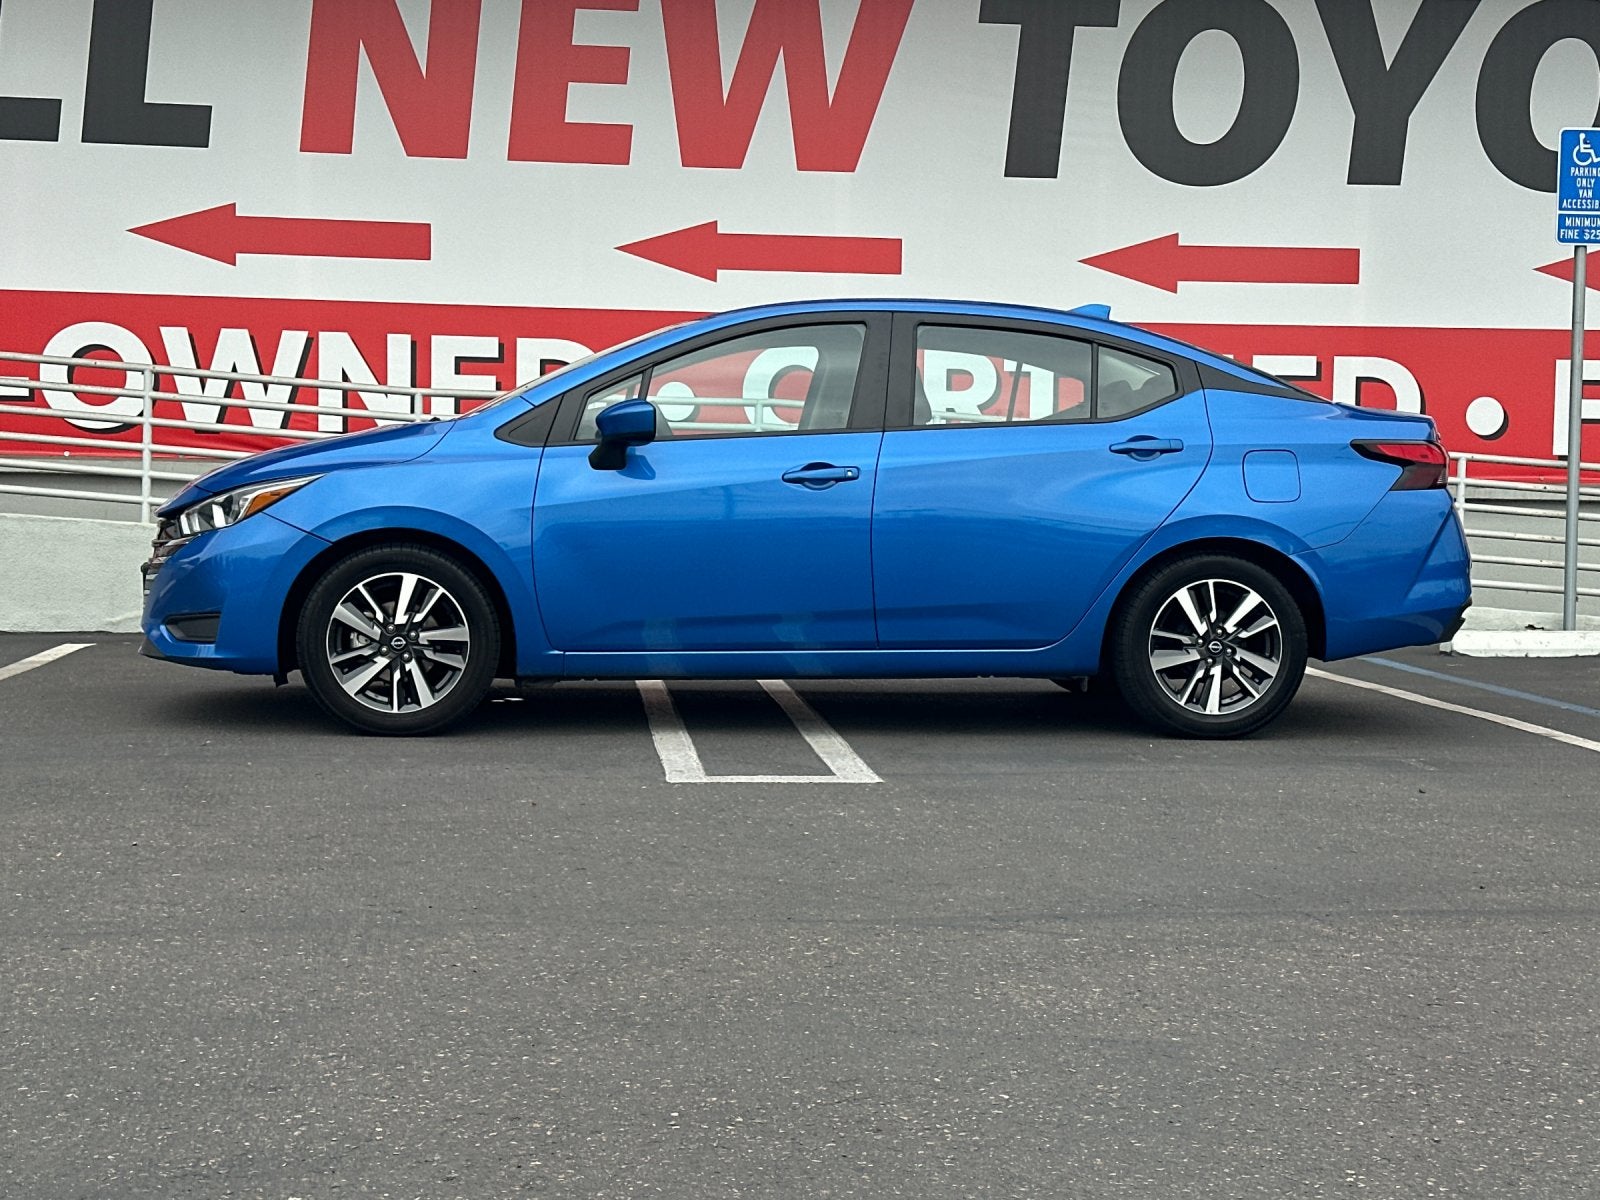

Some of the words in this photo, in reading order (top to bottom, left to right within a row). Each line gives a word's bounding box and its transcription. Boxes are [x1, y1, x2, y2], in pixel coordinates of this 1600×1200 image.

[299, 0, 915, 173] NEW
[978, 0, 1600, 193] TOYO
[1576, 177, 1596, 188] ONLY
[1578, 188, 1593, 199] VAN
[1560, 229, 1580, 240] FINE
